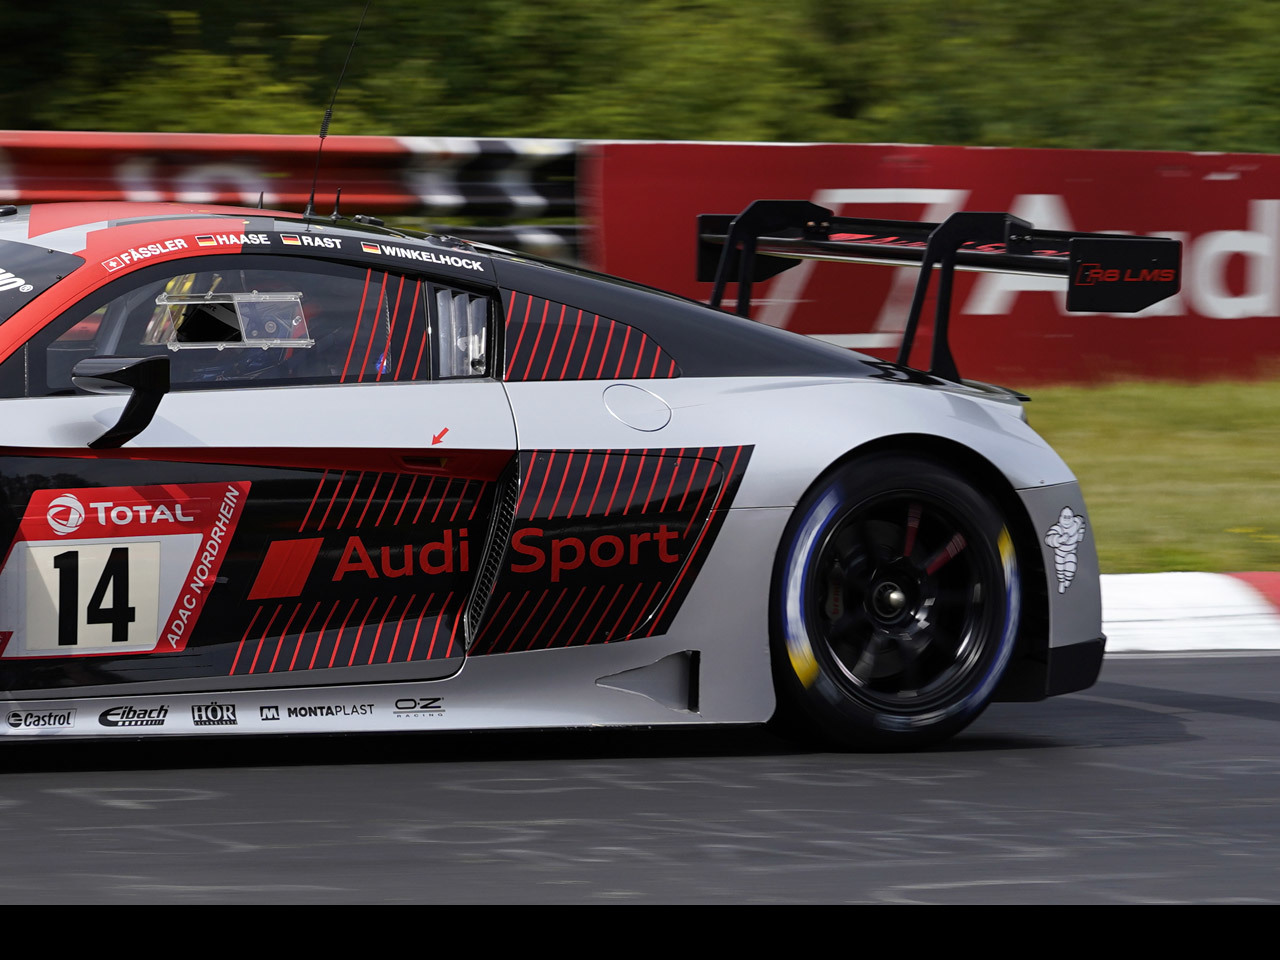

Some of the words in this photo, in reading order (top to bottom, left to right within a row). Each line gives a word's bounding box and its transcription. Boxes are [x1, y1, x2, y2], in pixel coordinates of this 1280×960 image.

[217, 234, 271, 245] HAASE
[301, 236, 342, 249] RAST
[120, 238, 189, 265] FÄSSLER
[381, 245, 484, 272] WINKELHOCK
[1123, 269, 1176, 282] LMS
[89, 501, 194, 525] TOTAL
[332, 527, 469, 581] Audi
[510, 524, 679, 582] Sport
[166, 594, 197, 649] ADAC
[190, 485, 241, 594] NORDRHEIN
[54, 547, 136, 646] 14
[23, 711, 71, 728] Castrol
[98, 705, 169, 727] Eibach
[193, 701, 236, 721] HÖR
[287, 704, 375, 718] MONTAPLAST
